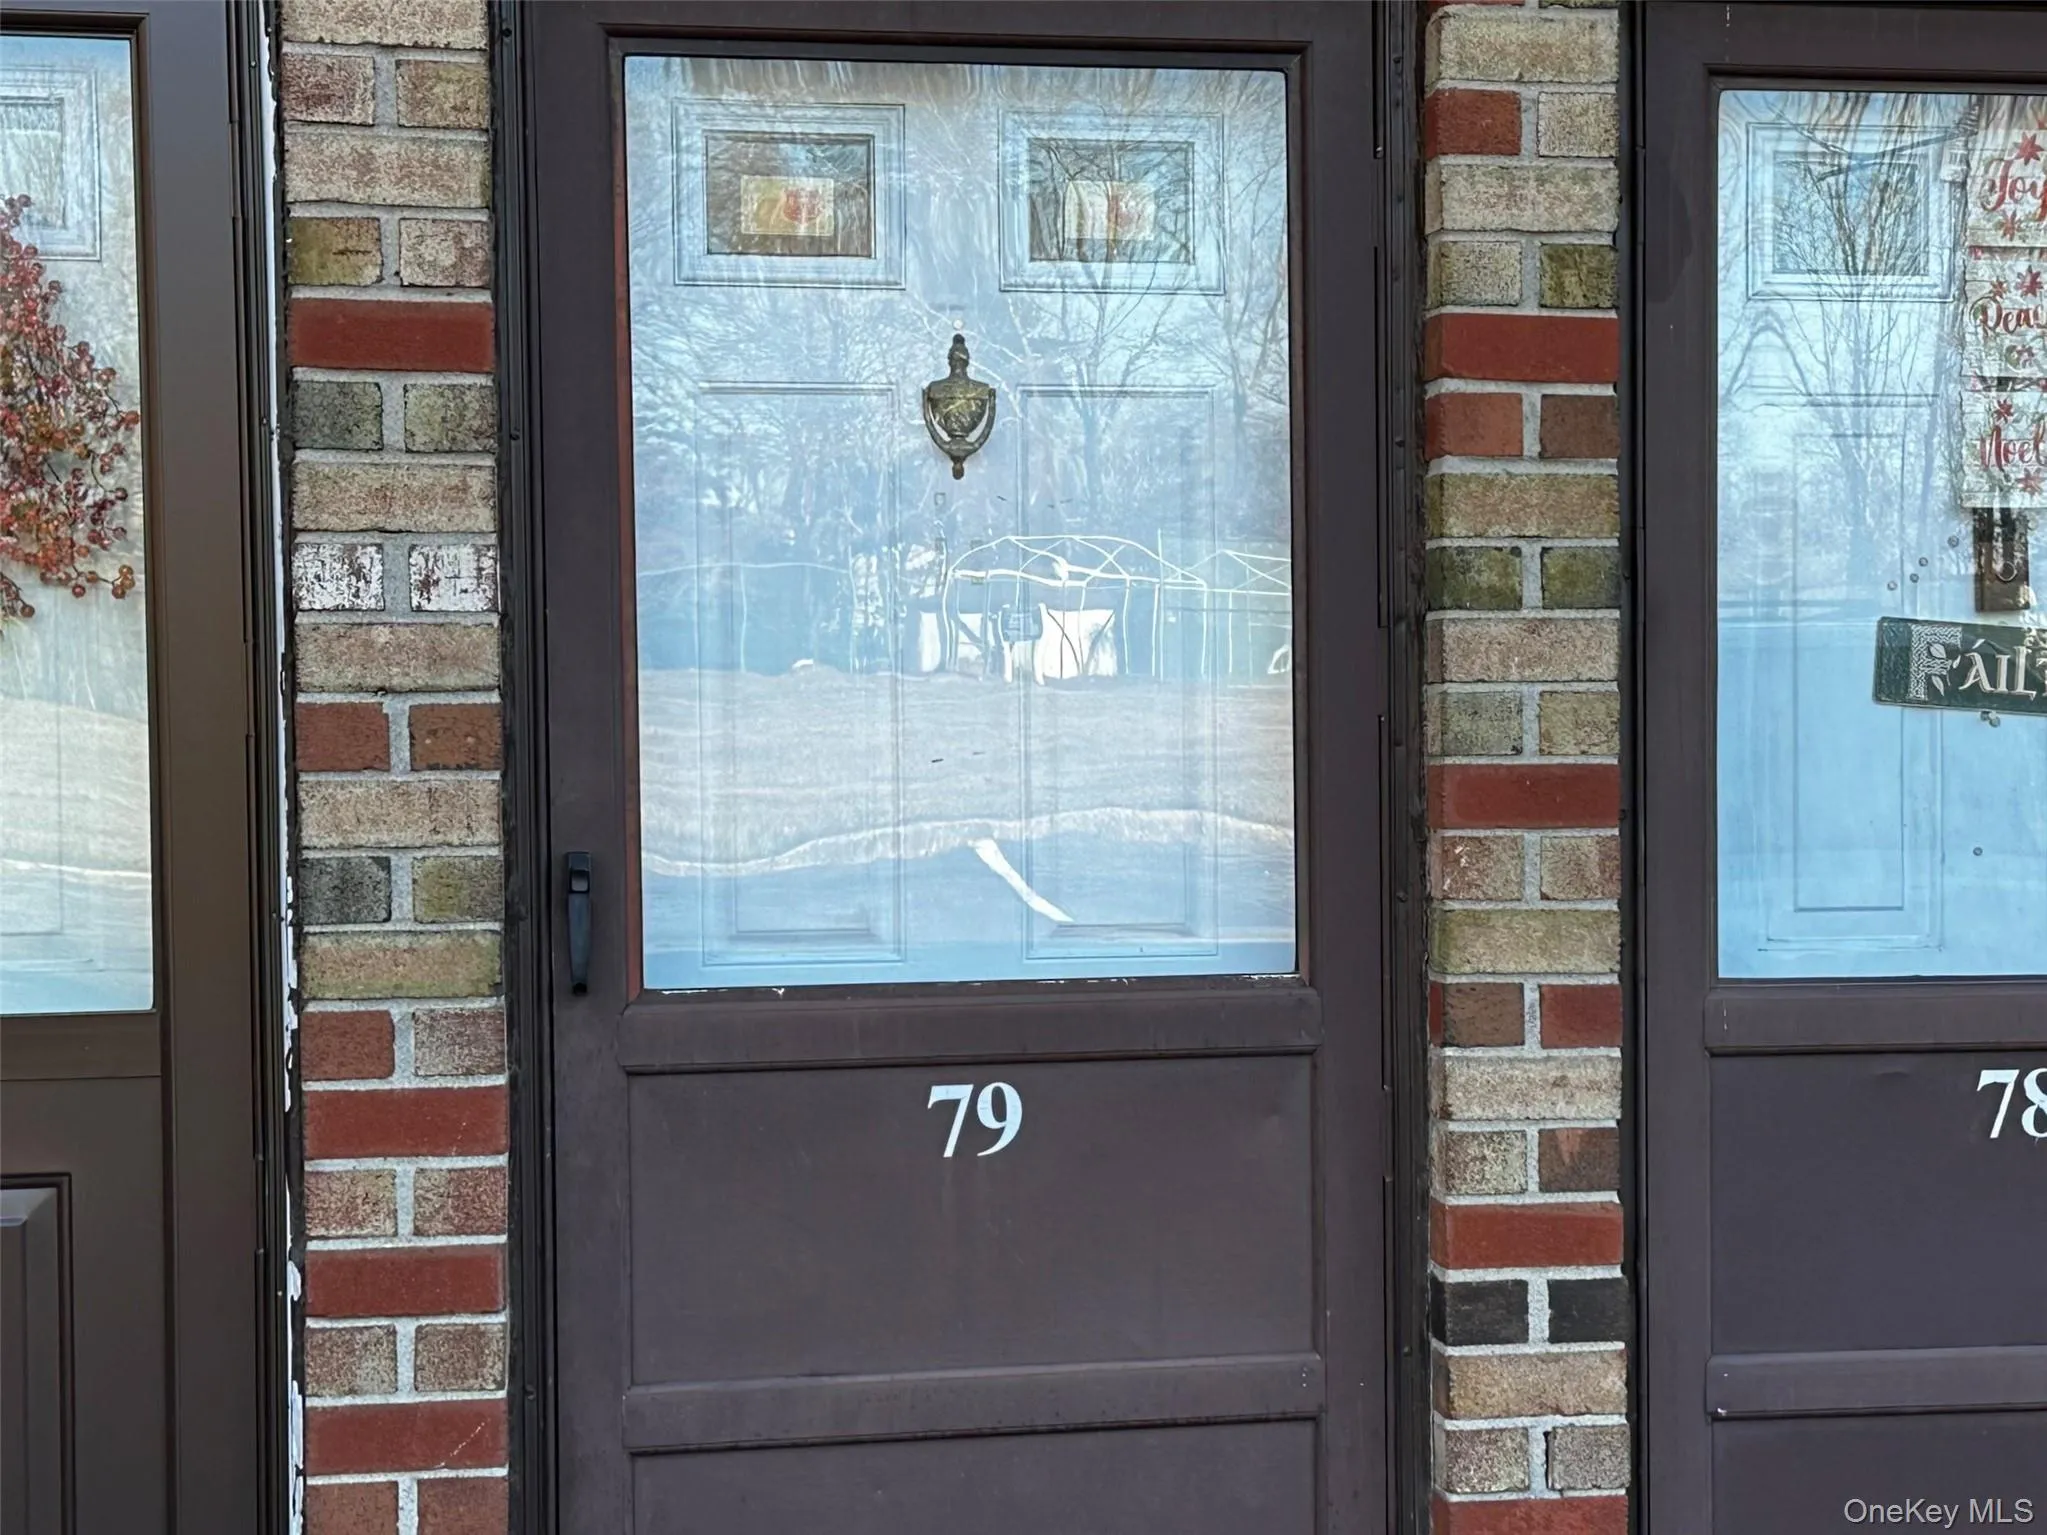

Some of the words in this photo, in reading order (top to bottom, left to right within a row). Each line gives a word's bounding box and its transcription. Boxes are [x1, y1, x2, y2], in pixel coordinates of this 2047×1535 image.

[1979, 417, 2047, 472] Noel
[927, 1082, 1023, 1158] 79
[1976, 1067, 2047, 1138] 78
